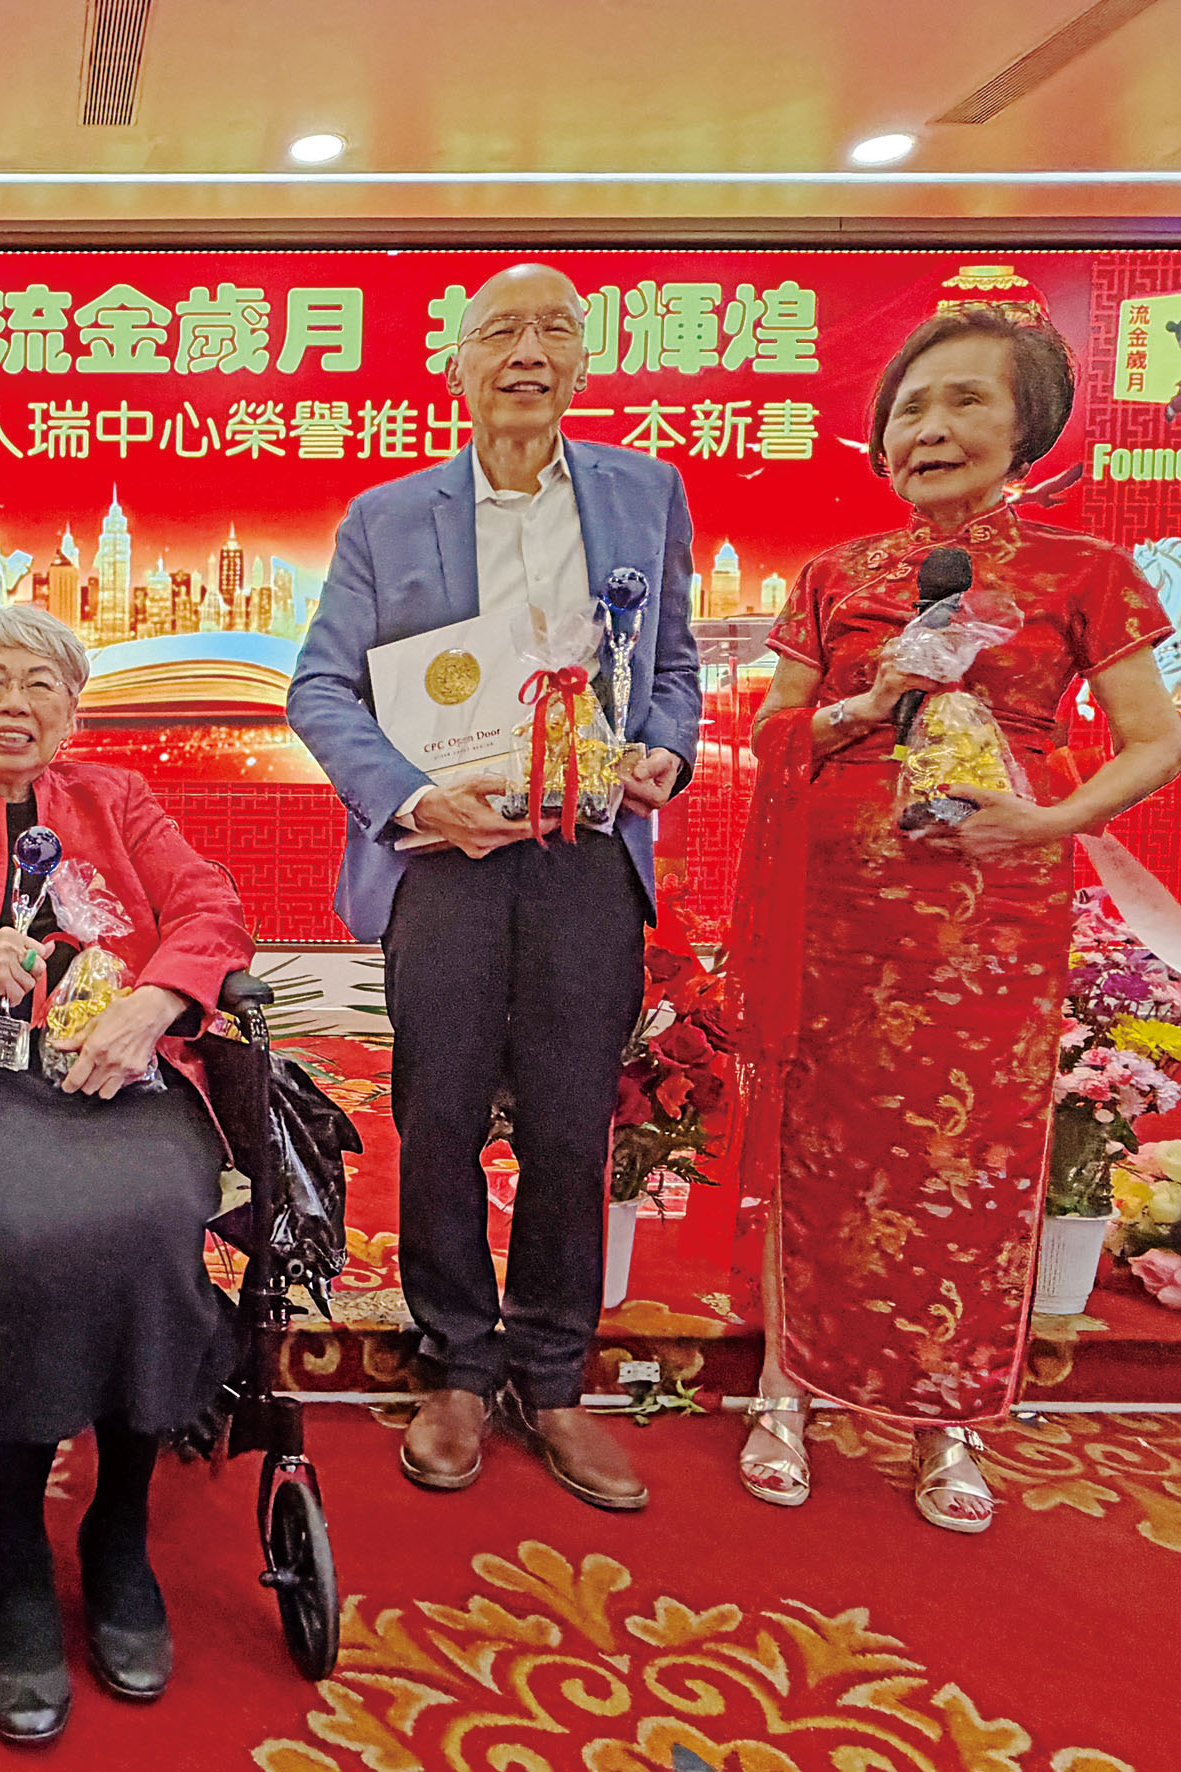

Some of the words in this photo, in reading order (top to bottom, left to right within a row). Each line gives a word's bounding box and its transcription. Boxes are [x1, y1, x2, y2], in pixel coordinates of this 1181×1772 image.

[1126, 305, 1150, 393] 流金歲月
[1093, 443, 1181, 481] Foun
[423, 740, 445, 753] CPC
[476, 728, 500, 740] Door
